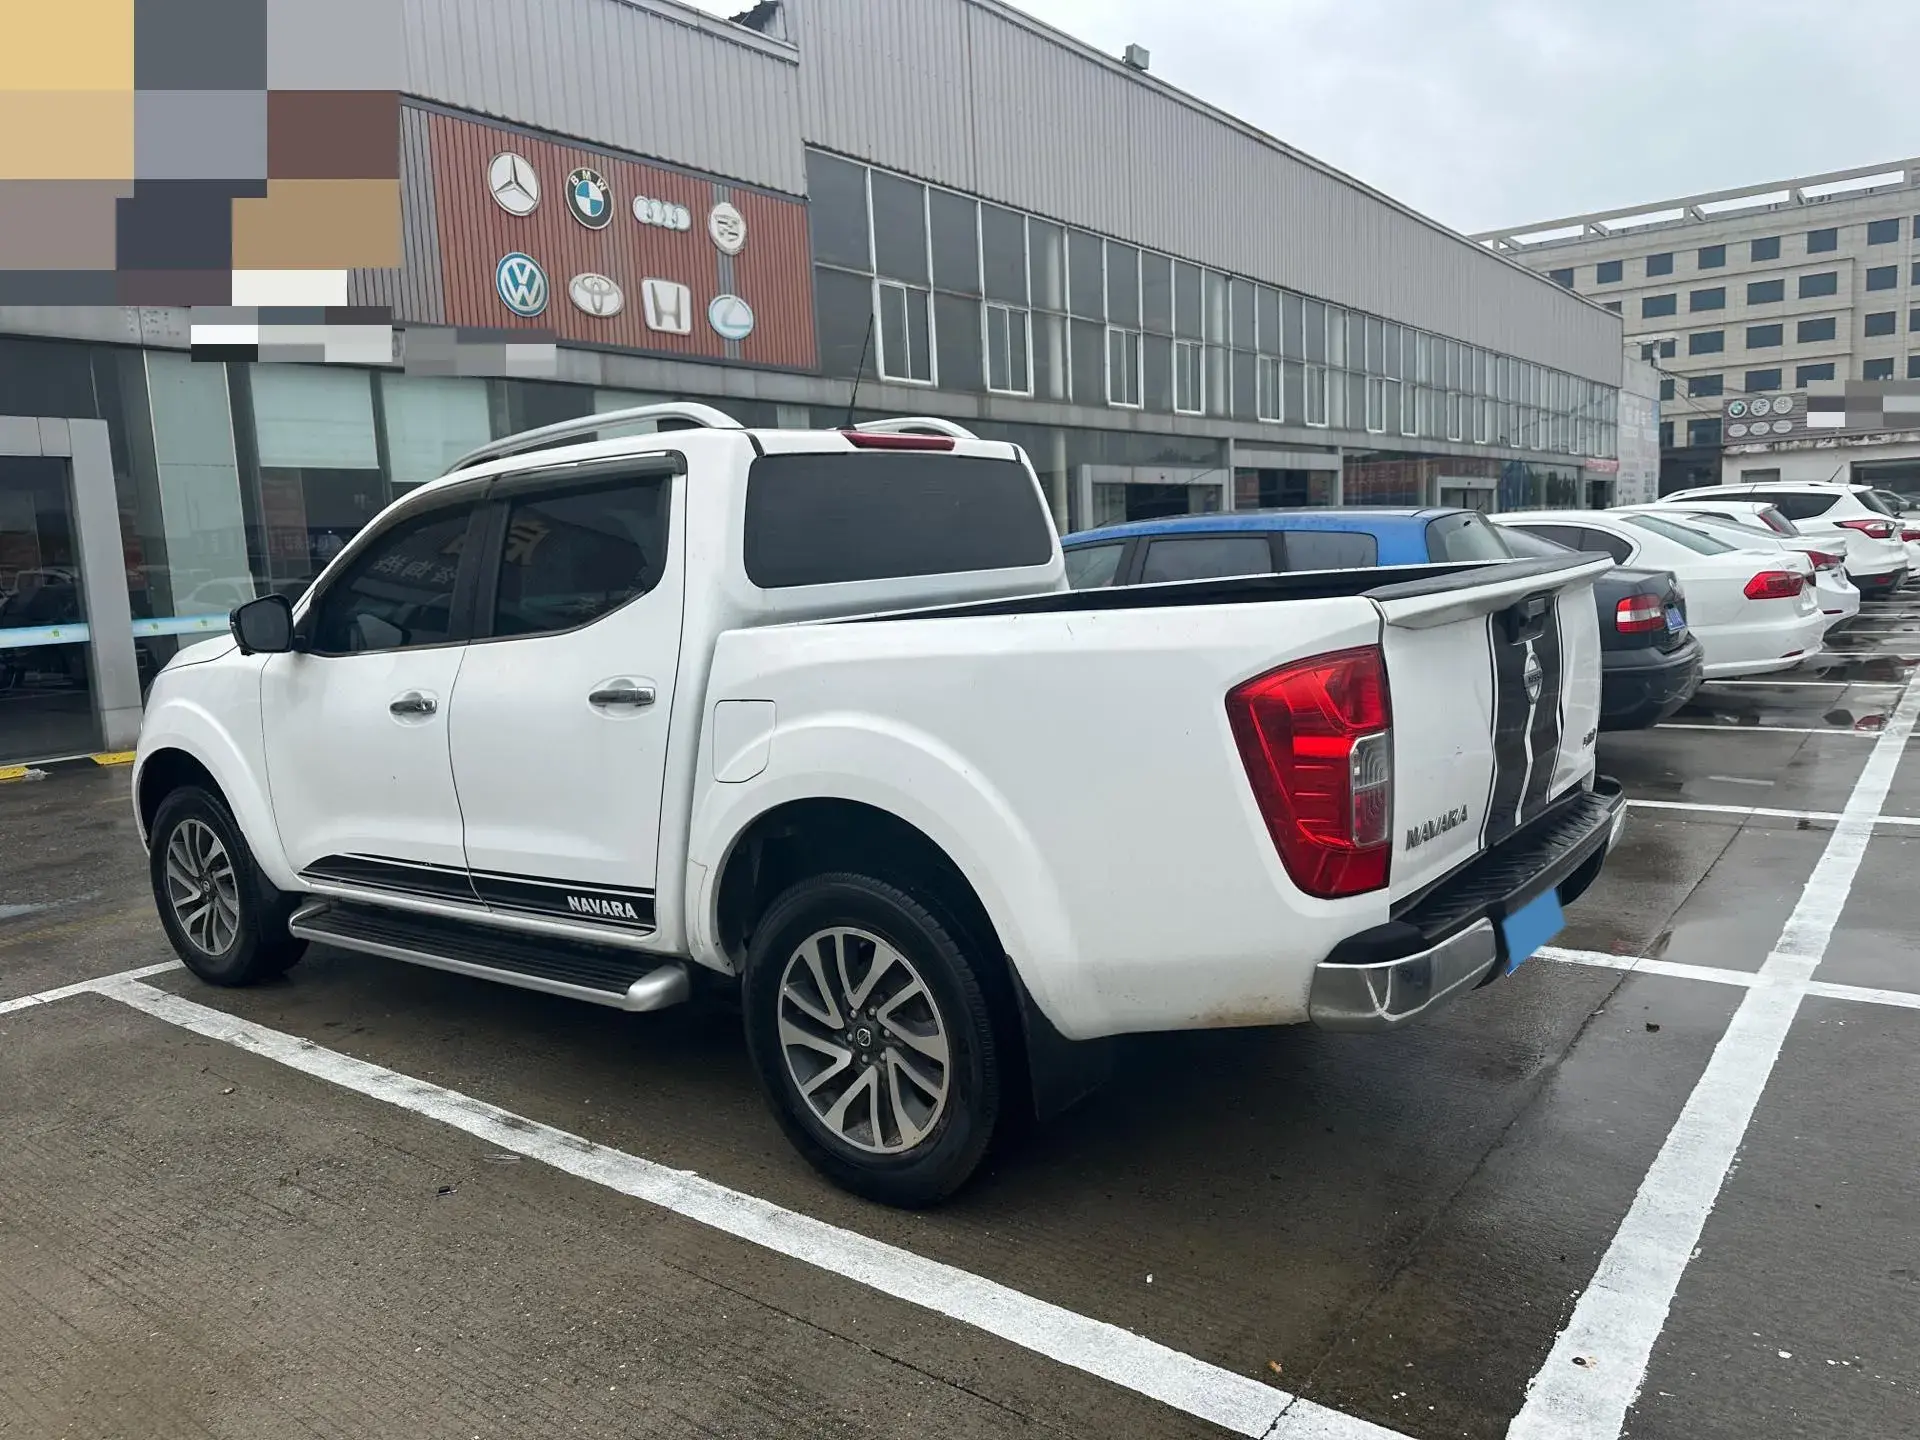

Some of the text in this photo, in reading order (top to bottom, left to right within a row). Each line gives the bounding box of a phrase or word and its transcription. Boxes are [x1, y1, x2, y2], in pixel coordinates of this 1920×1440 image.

[569, 169, 607, 192] BMW
[1406, 804, 1468, 851] NAVARA
[567, 895, 639, 919] NAVARA
